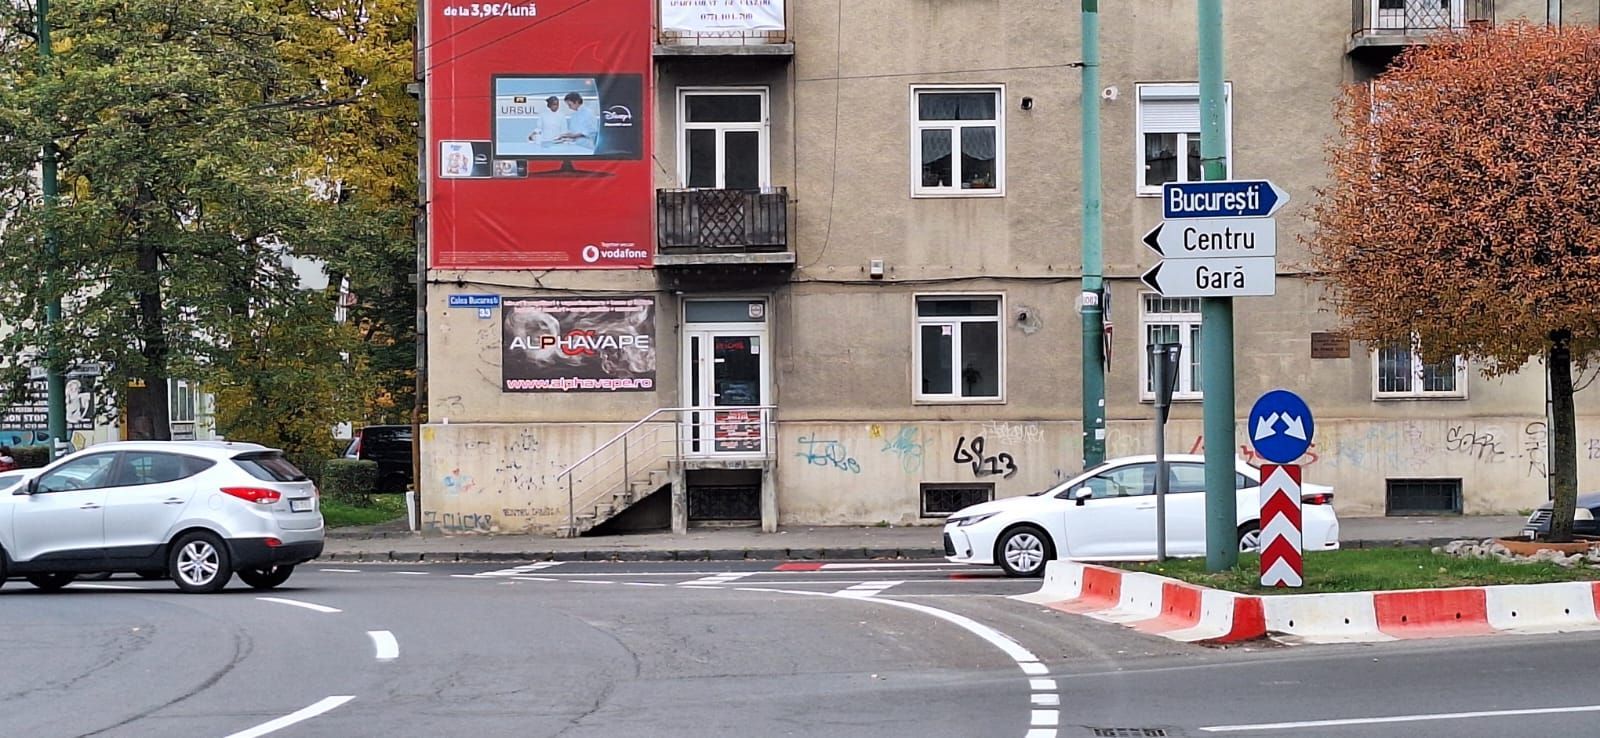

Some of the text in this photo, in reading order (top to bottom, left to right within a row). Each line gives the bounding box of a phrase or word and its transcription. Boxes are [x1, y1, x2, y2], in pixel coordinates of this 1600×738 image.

[444, 3, 537, 18] de la 3,9€/lună
[501, 105, 539, 115] URSUL
[1169, 187, 1260, 215] București
[1183, 226, 1255, 251] Centru
[600, 247, 647, 259] vodafone
[1195, 265, 1245, 290] Gară
[479, 308, 491, 318] 33
[510, 335, 649, 350] ALPHAVAPE
[506, 377, 653, 391] www.alphavape.ro
[23, 414, 47, 422] STOP
